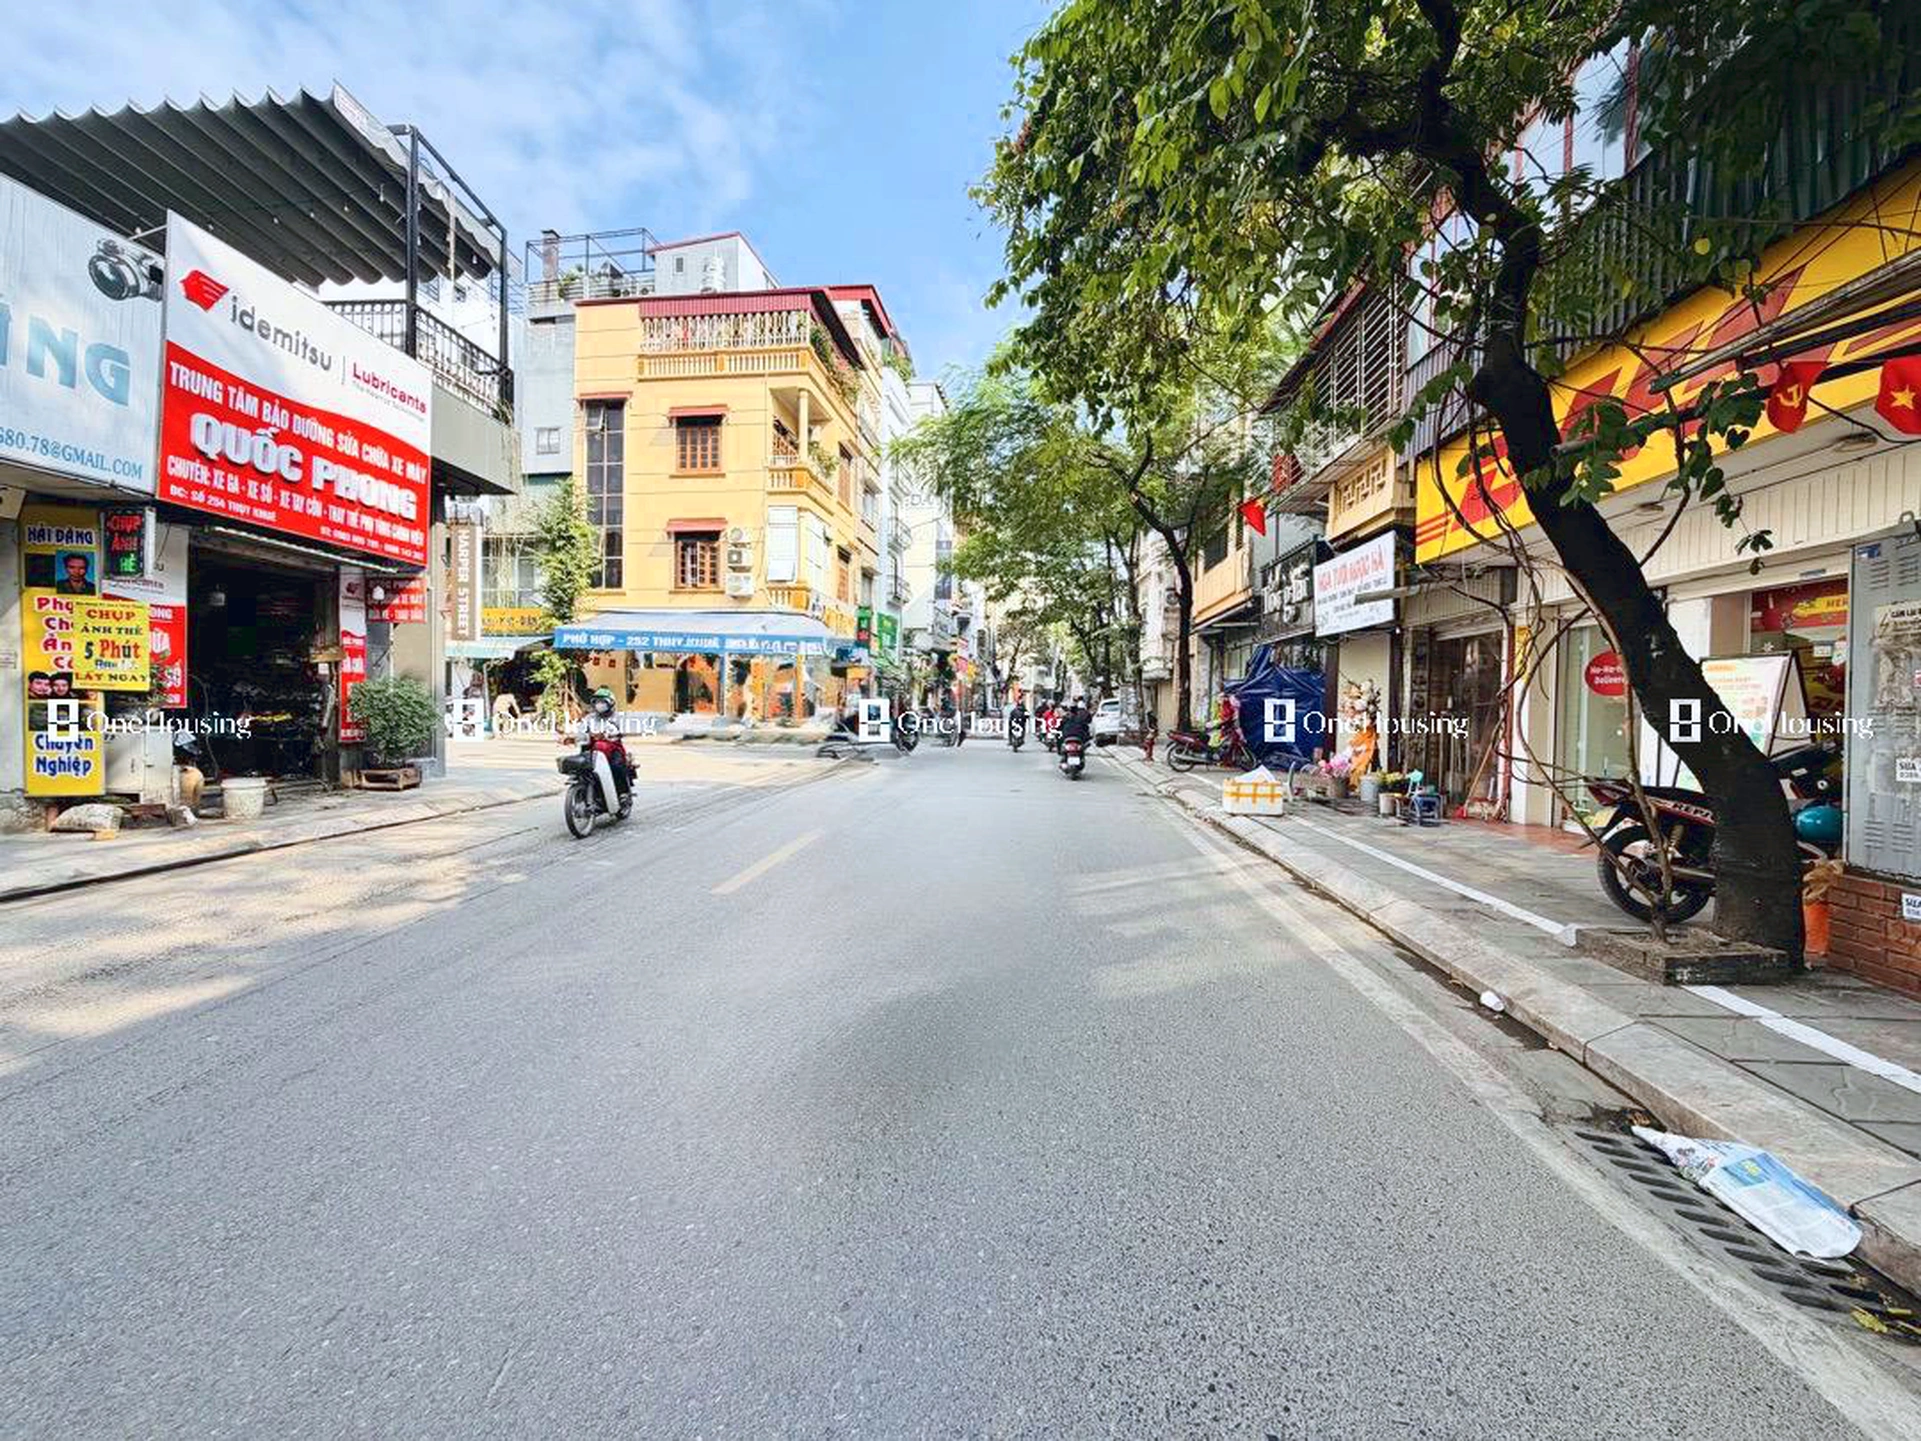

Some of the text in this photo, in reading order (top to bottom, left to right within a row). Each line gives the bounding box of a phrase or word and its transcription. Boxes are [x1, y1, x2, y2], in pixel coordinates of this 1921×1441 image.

[231, 296, 332, 371] idemitsu
[353, 362, 427, 414] Lubricants
[170, 361, 223, 402] TRUNG
[262, 399, 289, 429] BẢO
[293, 414, 334, 449] DƯỠNG
[337, 430, 360, 459] SỬA
[391, 455, 404, 476] XE
[190, 413, 417, 520] QUỐC PHONG
[212, 468, 225, 490] XE
[227, 473, 239, 494] GA
[247, 479, 259, 500] XE
[458, 529, 470, 636] HARPER STREET
[86, 609, 136, 621] CHỤP
[85, 641, 94, 659] 5
[99, 639, 141, 659] Phút
[36, 757, 92, 776] Nghiệp
